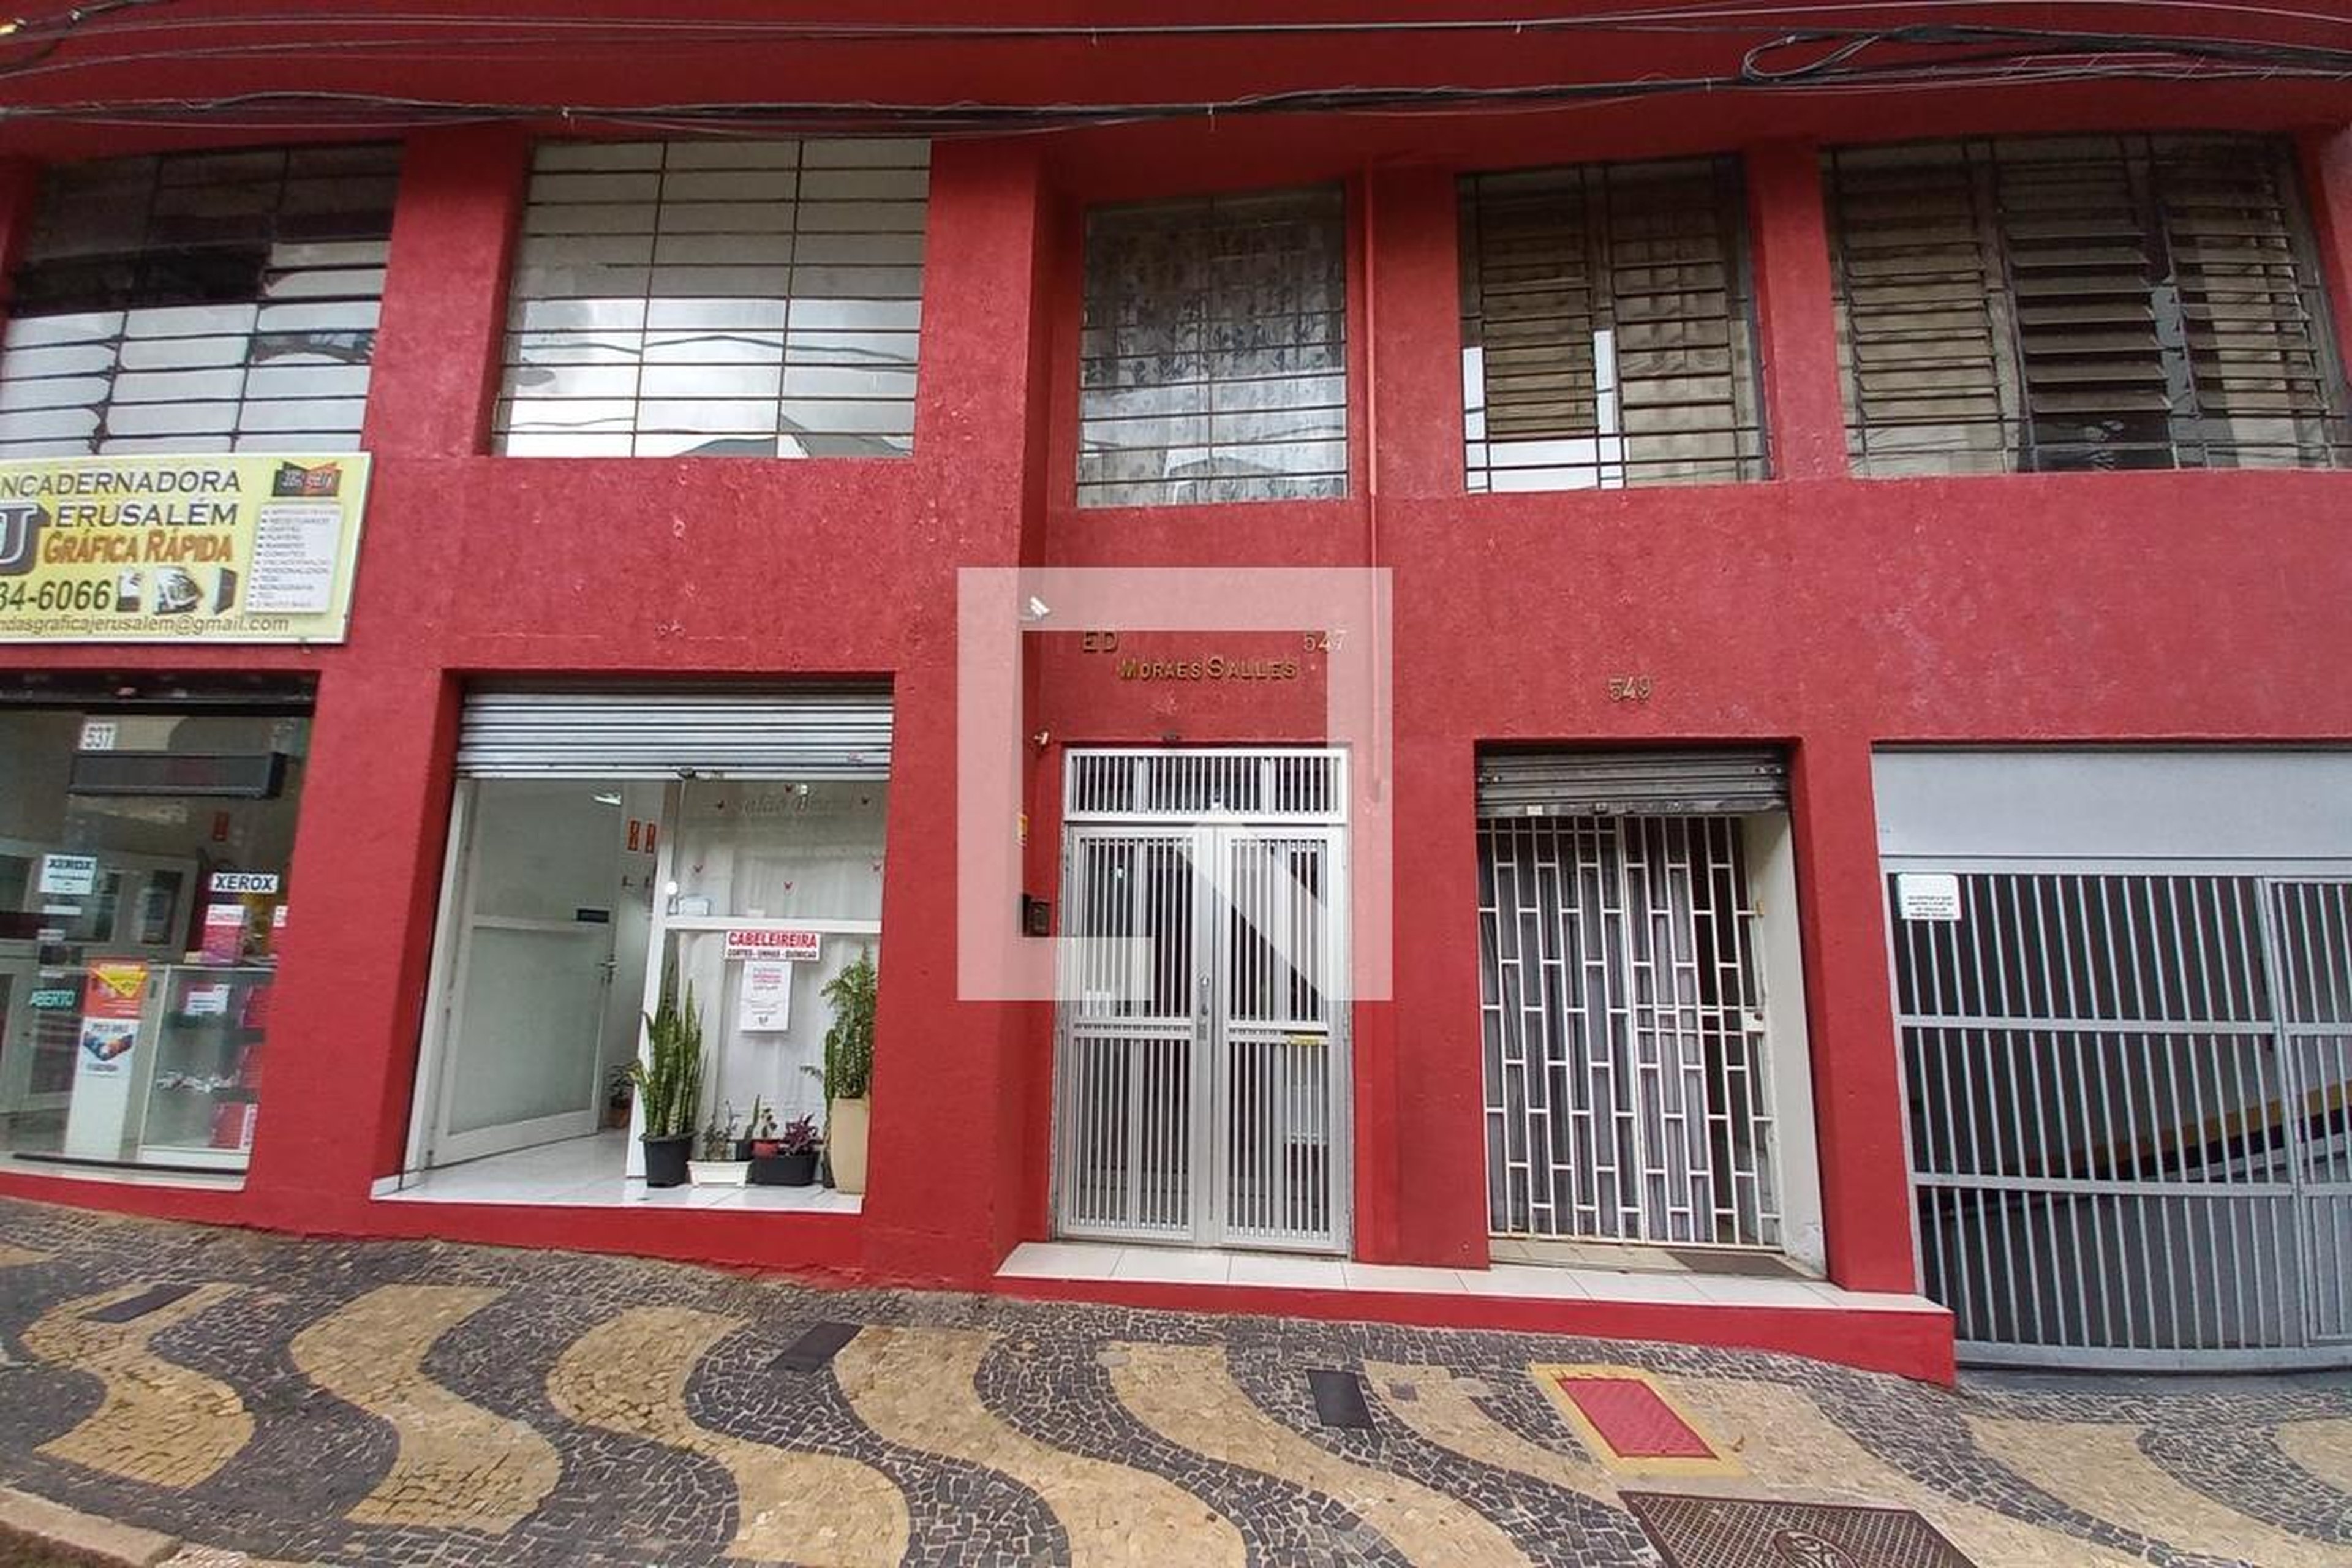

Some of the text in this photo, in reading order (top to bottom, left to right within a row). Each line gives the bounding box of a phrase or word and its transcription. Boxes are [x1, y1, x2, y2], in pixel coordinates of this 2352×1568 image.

[44, 527, 232, 564] GRÁFICA RÁPIDA
[1082, 628, 1119, 653] ED
[1303, 629, 1347, 653] 547
[1609, 676, 1651, 703] 549
[215, 875, 274, 891] XEROX
[728, 932, 817, 948] CABELEIREIRA
